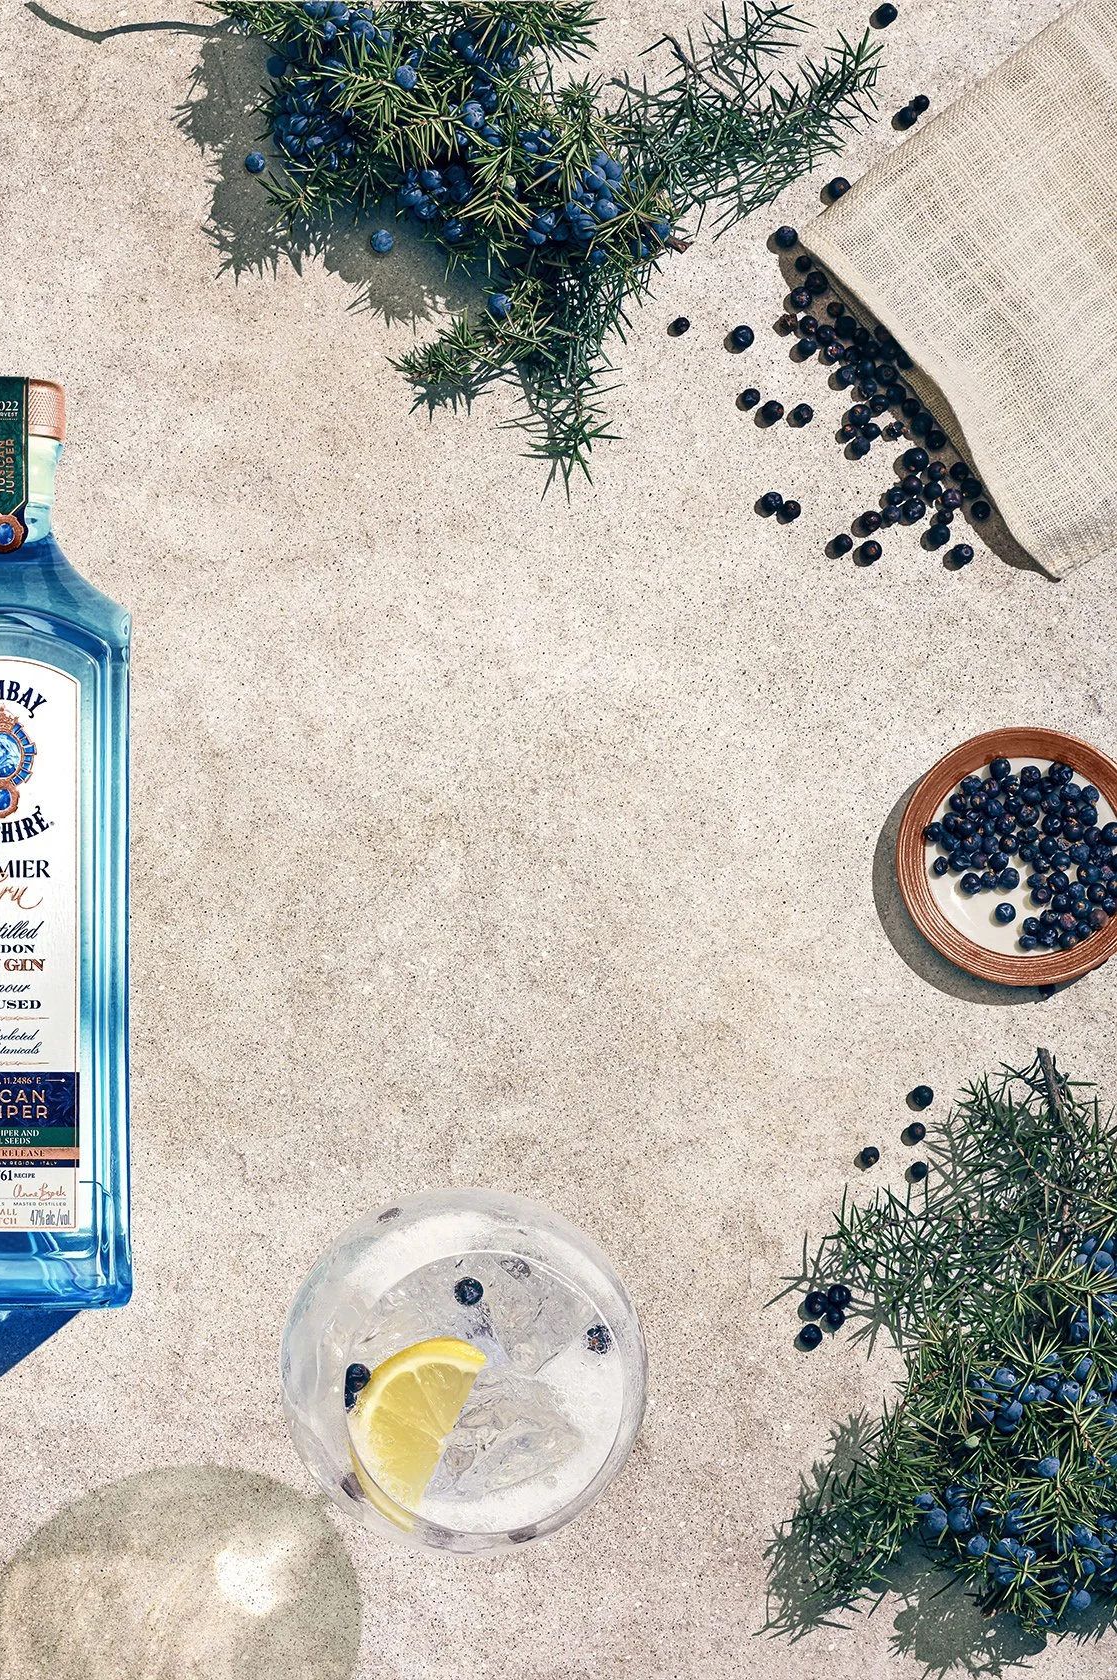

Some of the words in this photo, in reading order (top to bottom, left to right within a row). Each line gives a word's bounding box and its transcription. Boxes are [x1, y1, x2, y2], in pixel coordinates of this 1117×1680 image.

[6, 438, 14, 494] JUNIPER
[4, 958, 45, 971] GIN
[30, 1209, 44, 1226] 47%
